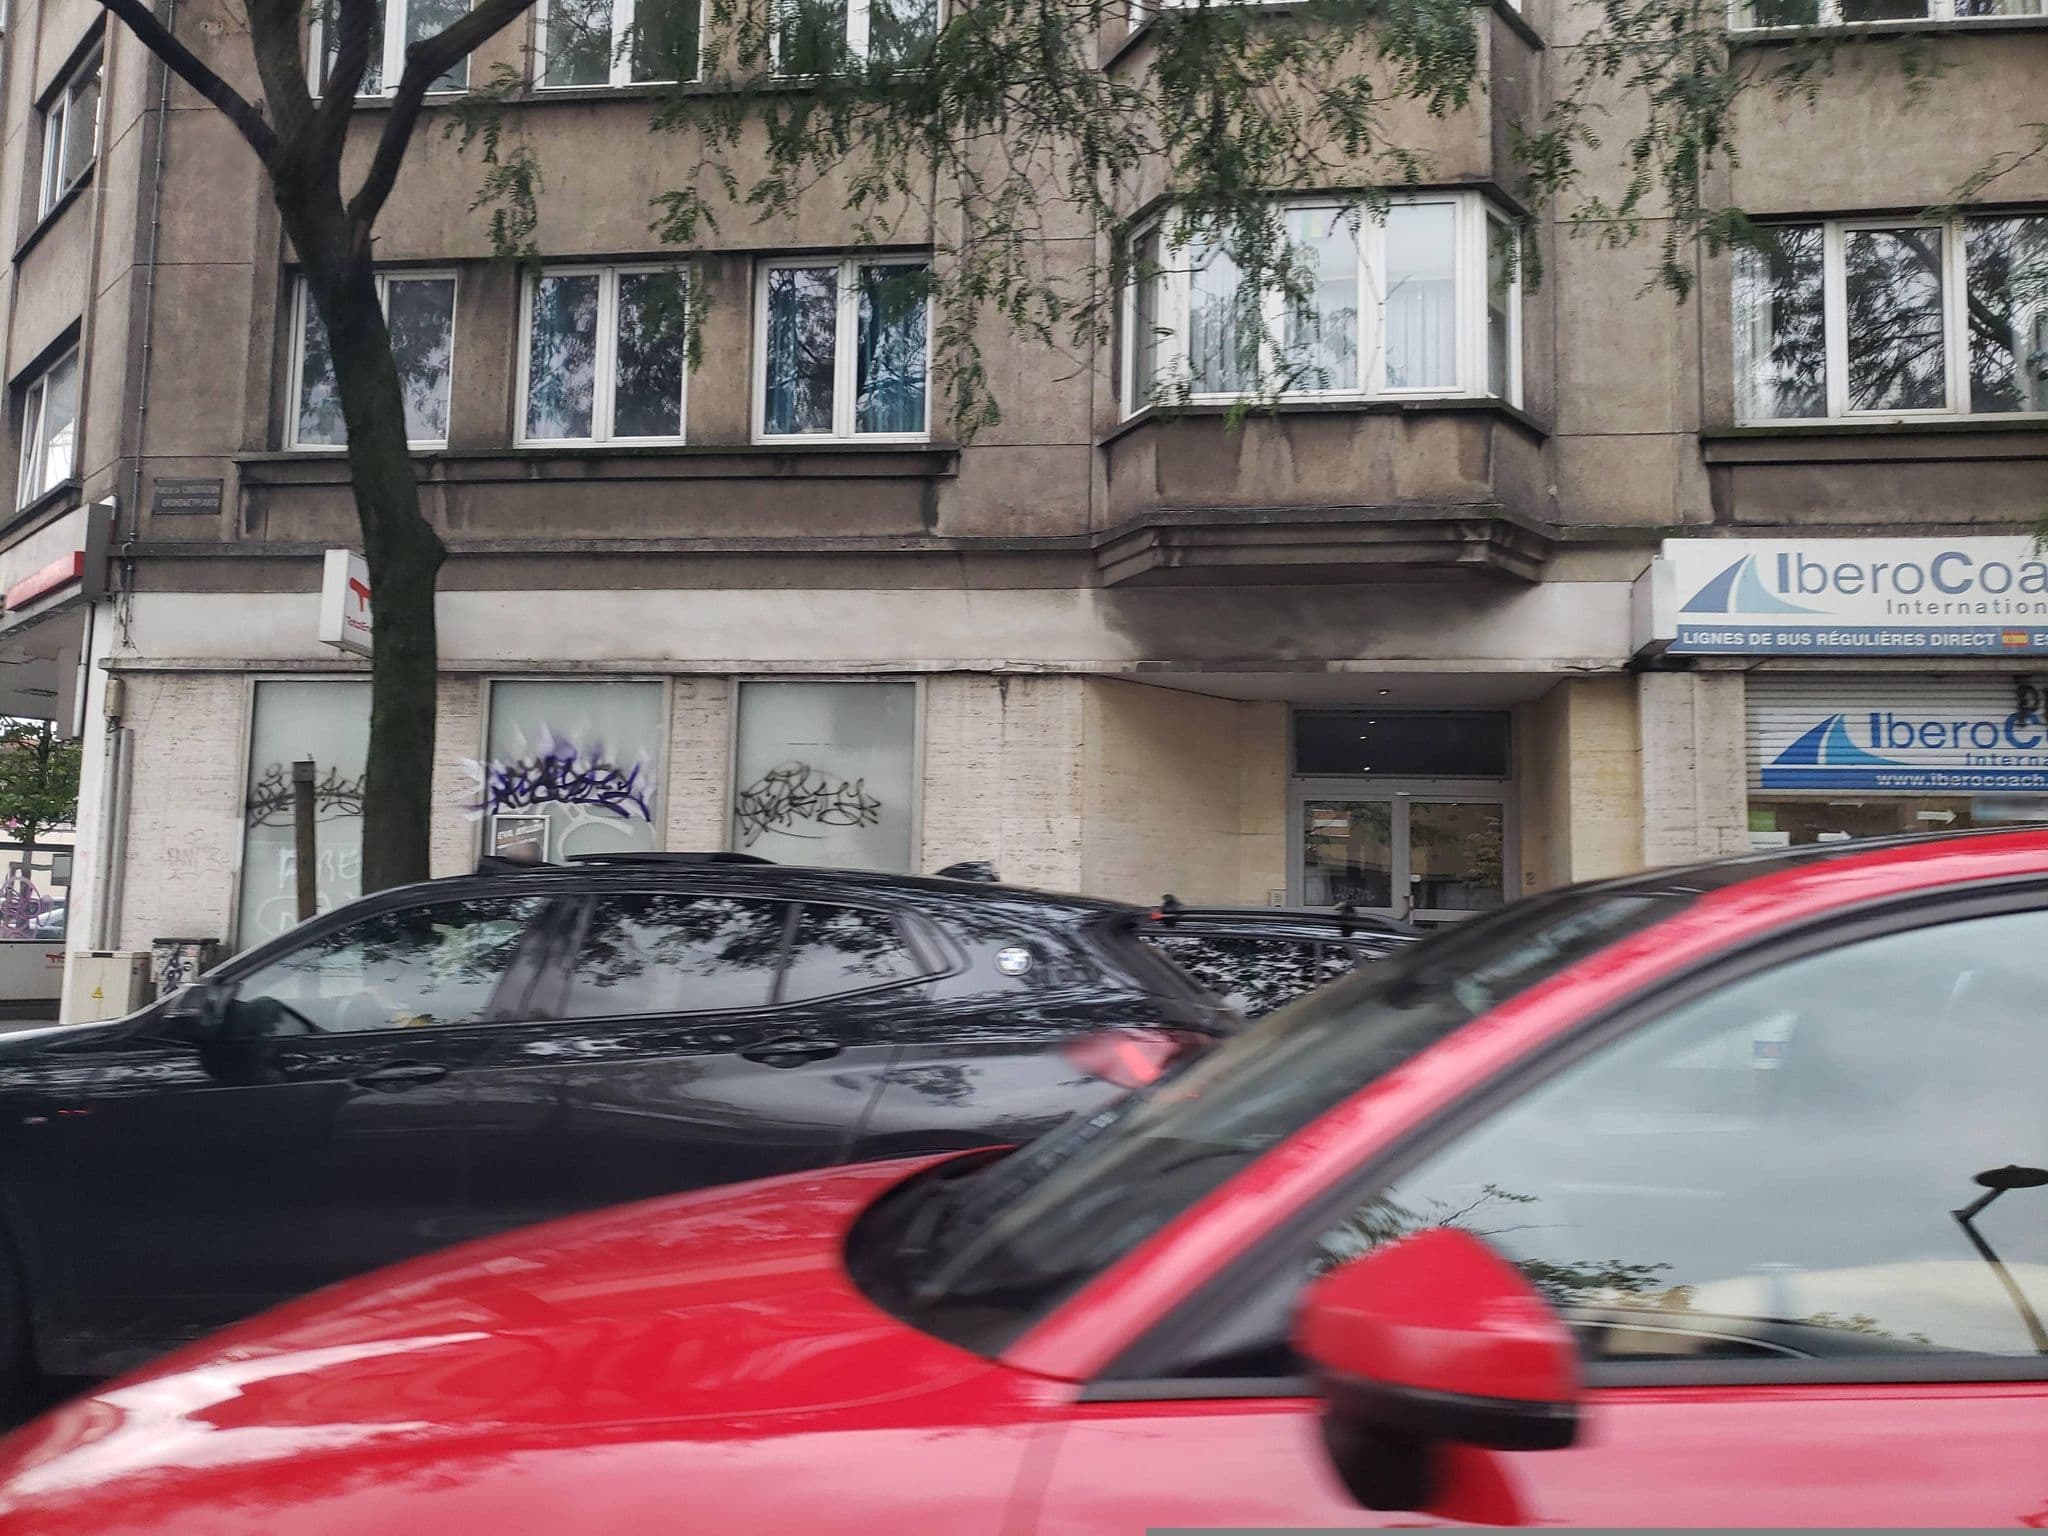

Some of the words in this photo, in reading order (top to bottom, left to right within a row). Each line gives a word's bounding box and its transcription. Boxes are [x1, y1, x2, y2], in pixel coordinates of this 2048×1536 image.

[1777, 551, 2048, 595] IberoCoa
[1886, 599, 2047, 615] Internation
[1683, 632, 1745, 645] LIGNES
[1749, 633, 1773, 645] DE
[1776, 633, 1812, 646] BUS
[1816, 630, 1926, 646] RÉGULIÈRES
[1930, 633, 1996, 646] DIRECT
